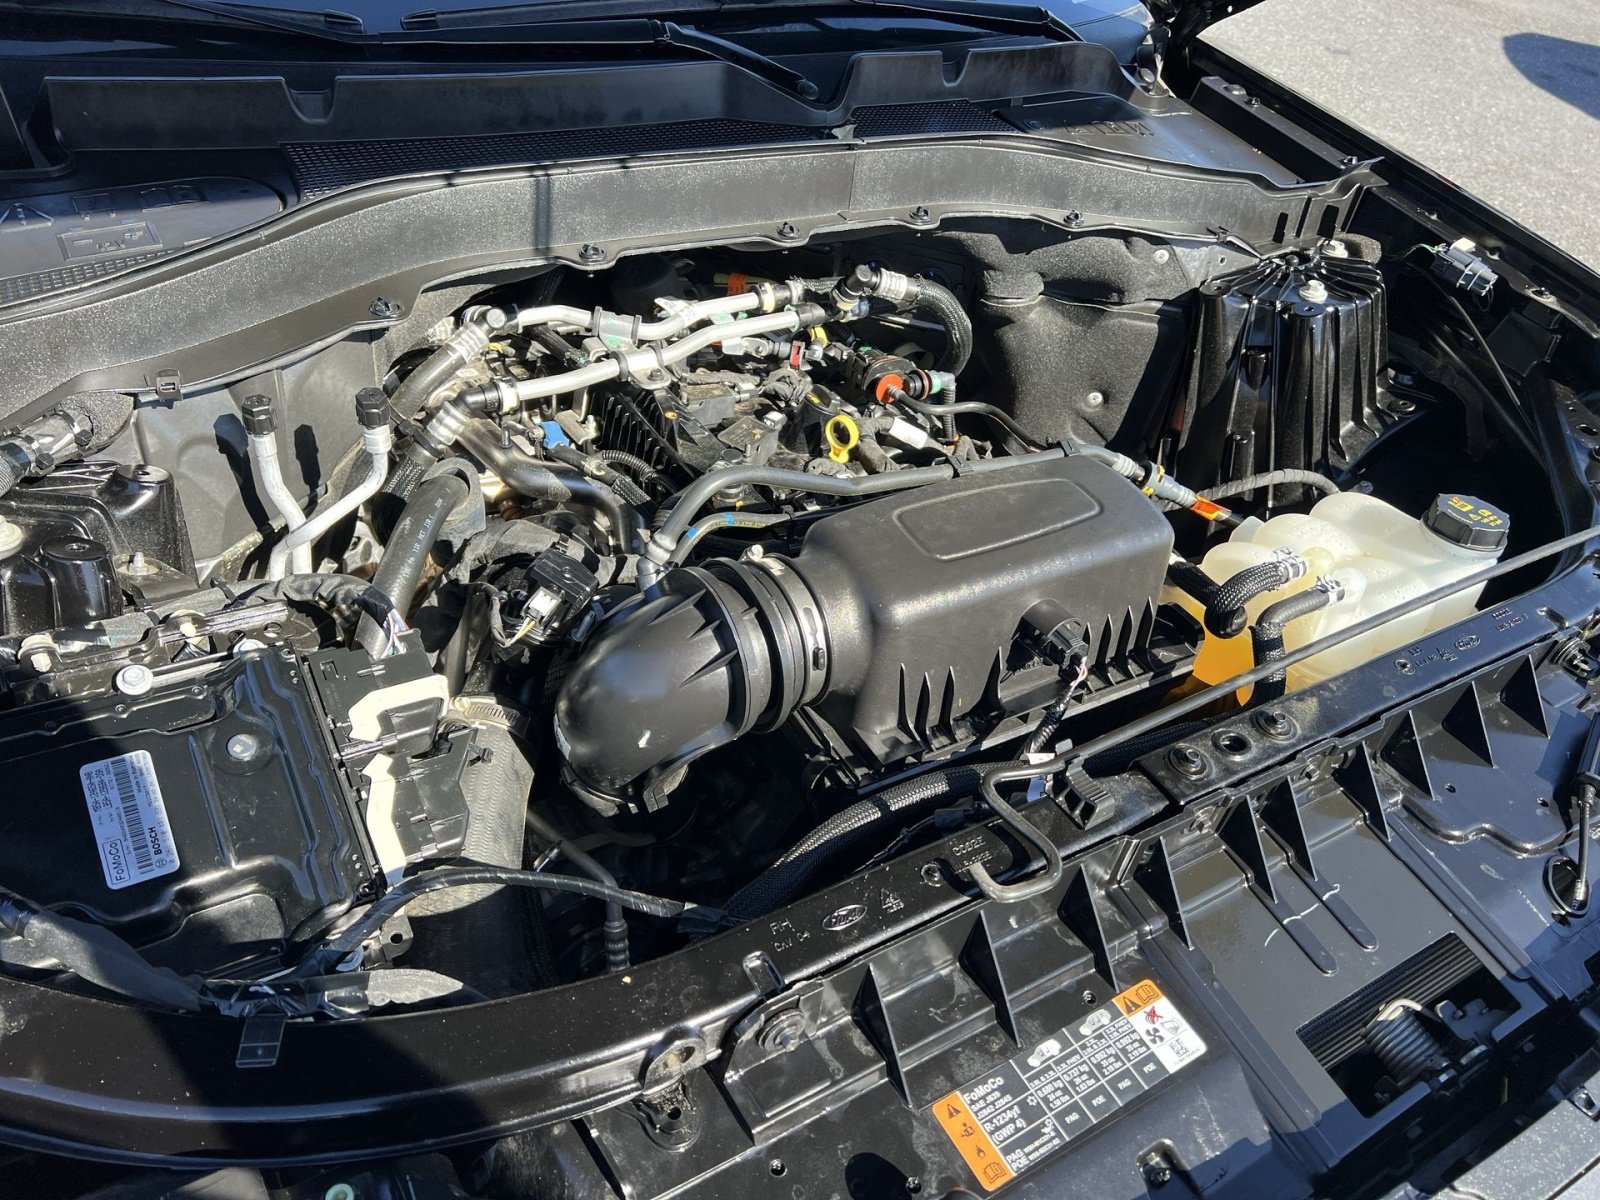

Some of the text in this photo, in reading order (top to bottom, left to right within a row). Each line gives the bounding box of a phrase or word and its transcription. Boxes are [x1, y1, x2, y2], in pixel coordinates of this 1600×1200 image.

[148, 827, 162, 855] BOSCH
[109, 842, 125, 881] FoMoCo
[1129, 1032, 1140, 1040] kg
[1105, 1047, 1116, 1055] kg
[1077, 1064, 1090, 1072] kg
[1143, 1063, 1156, 1073] POE
[1052, 1080, 1064, 1088] kg
[1118, 1079, 1131, 1090] PAG
[962, 1077, 1004, 1104] FoMoCo
[971, 1100, 986, 1112] SAE
[1092, 1095, 1106, 1106] POE
[984, 1105, 1020, 1132] R-1234yf
[1065, 1112, 1079, 1124] PAG
[992, 1118, 1027, 1144] (GWP 4)
[1006, 1149, 1024, 1163] PAG
[1011, 1156, 1029, 1171] POE
